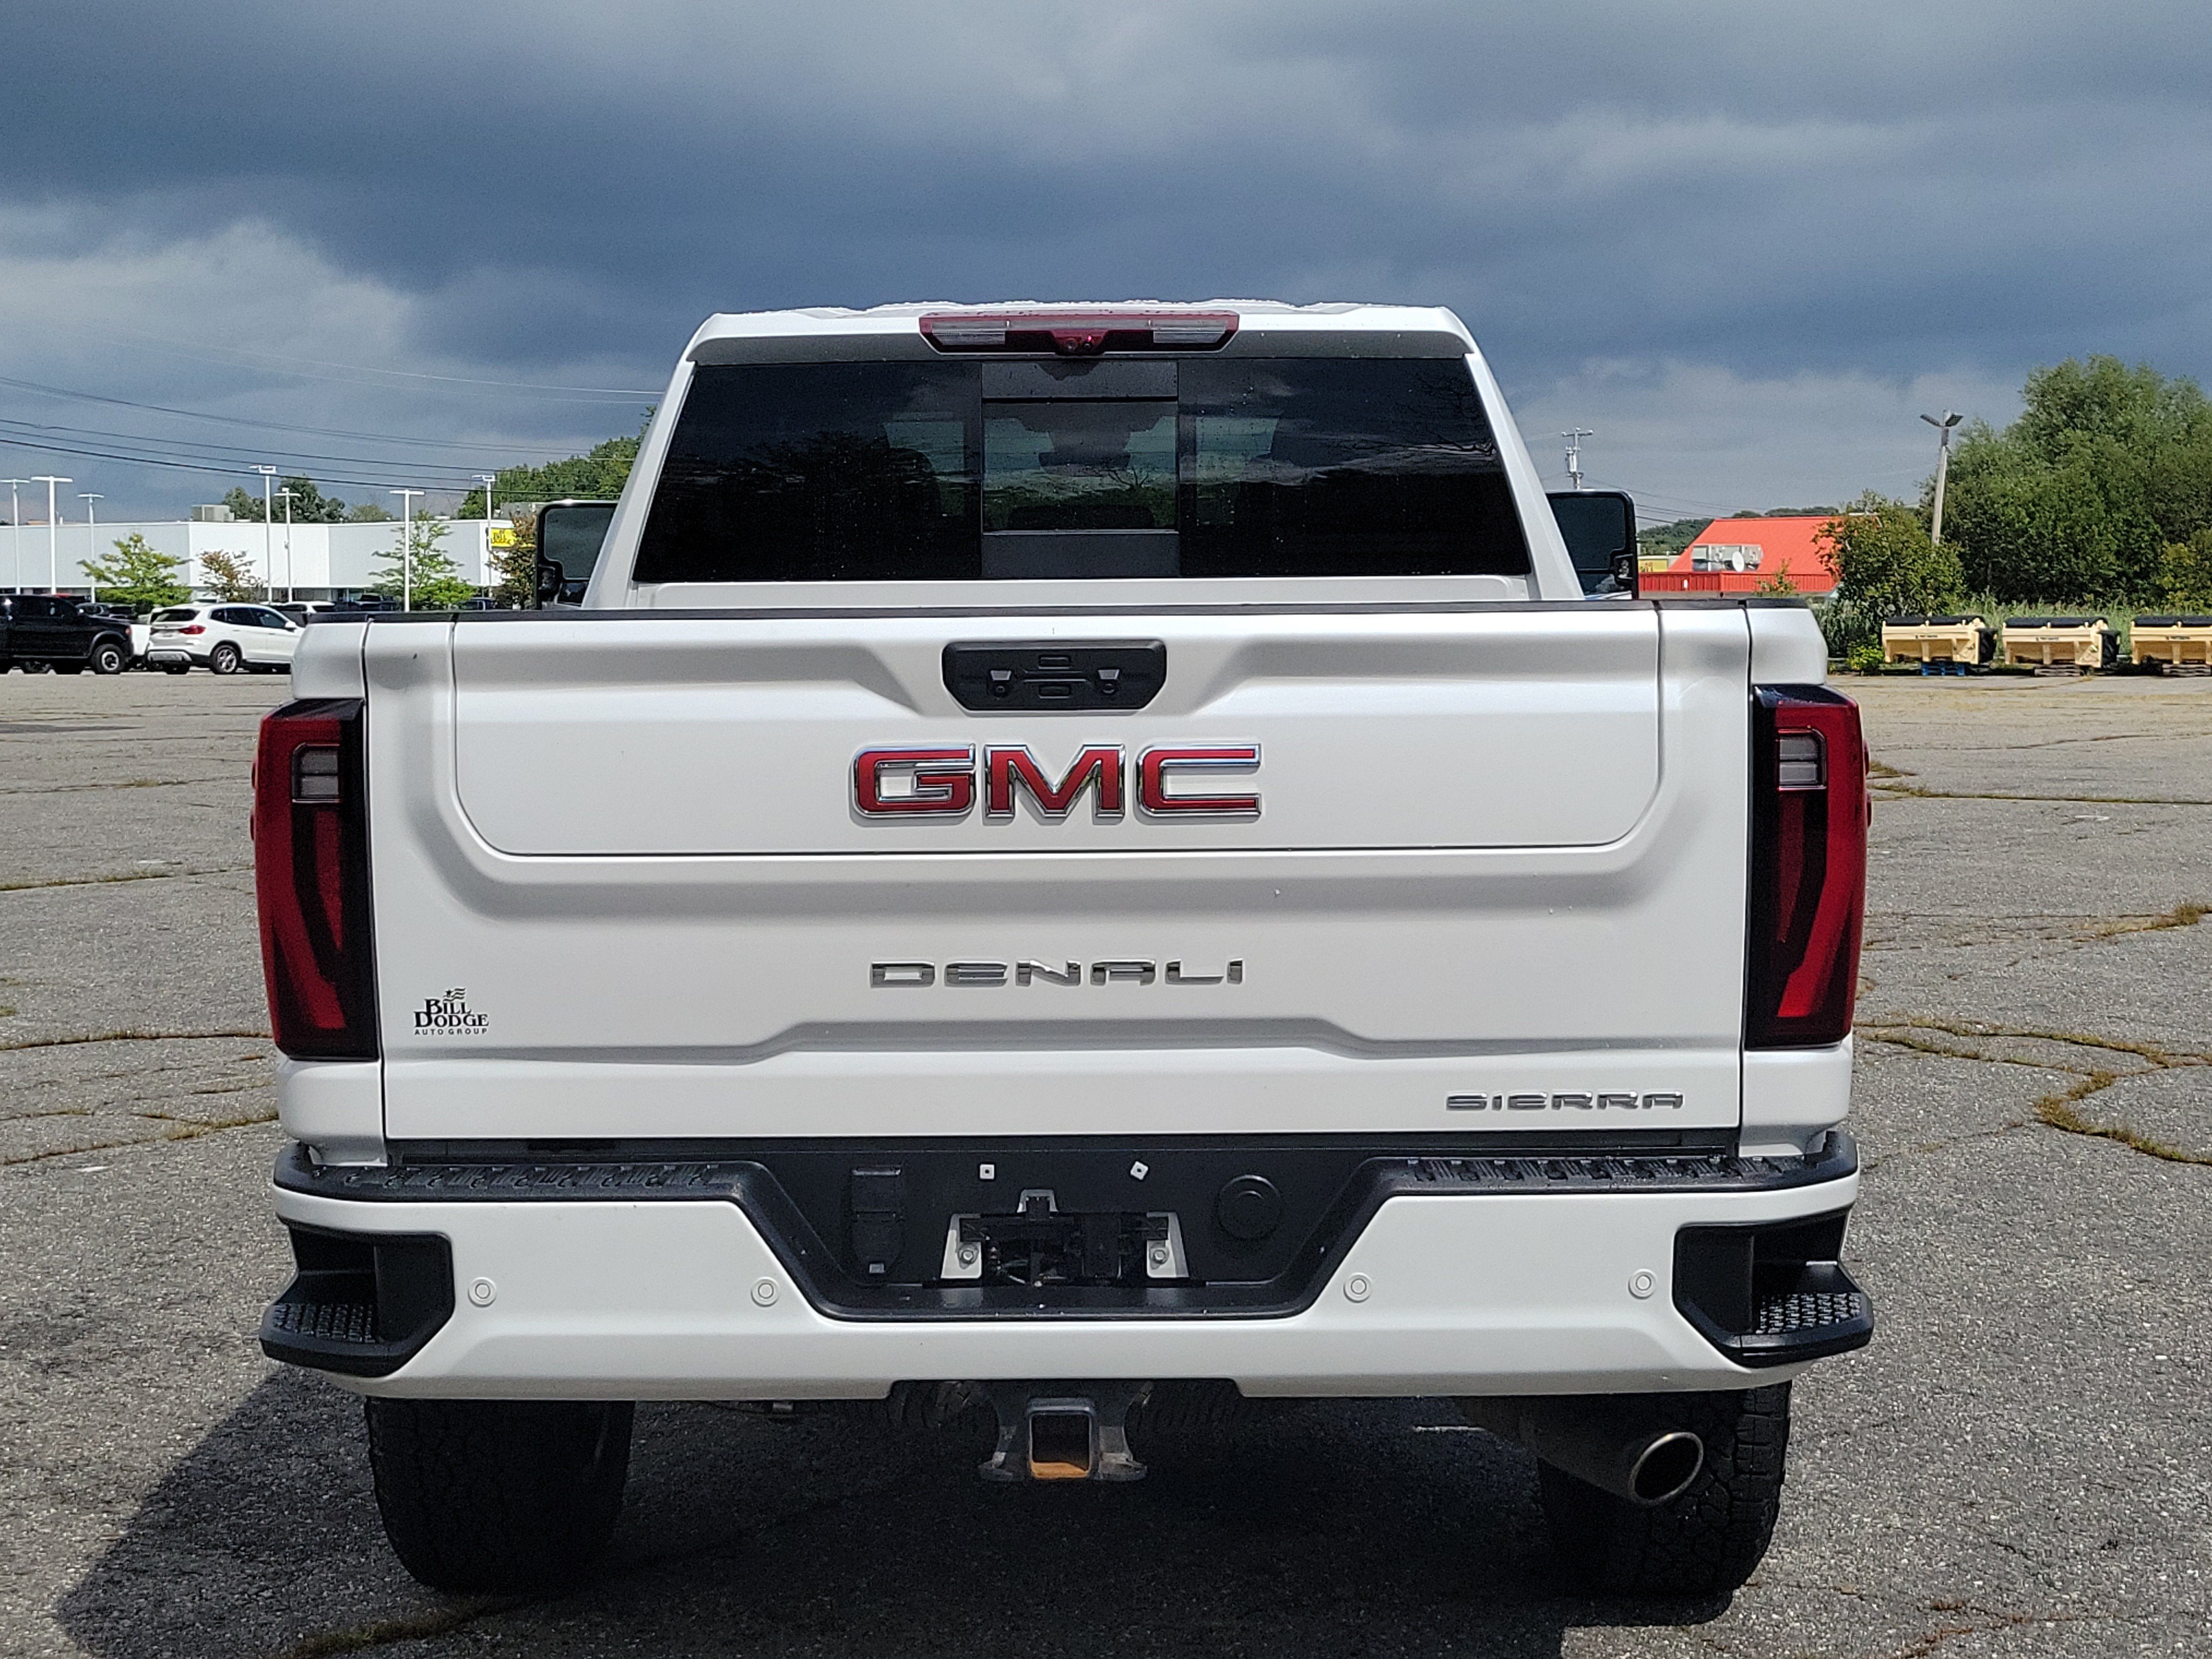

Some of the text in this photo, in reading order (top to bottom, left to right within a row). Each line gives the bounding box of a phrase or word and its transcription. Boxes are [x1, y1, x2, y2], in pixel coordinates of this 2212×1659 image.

[851, 743, 1262, 818] GMC
[870, 958, 1244, 988] DENALI
[424, 998, 471, 1014] BILL
[414, 1011, 489, 1027] DODGE
[1446, 1091, 1684, 1110] SIERRA
